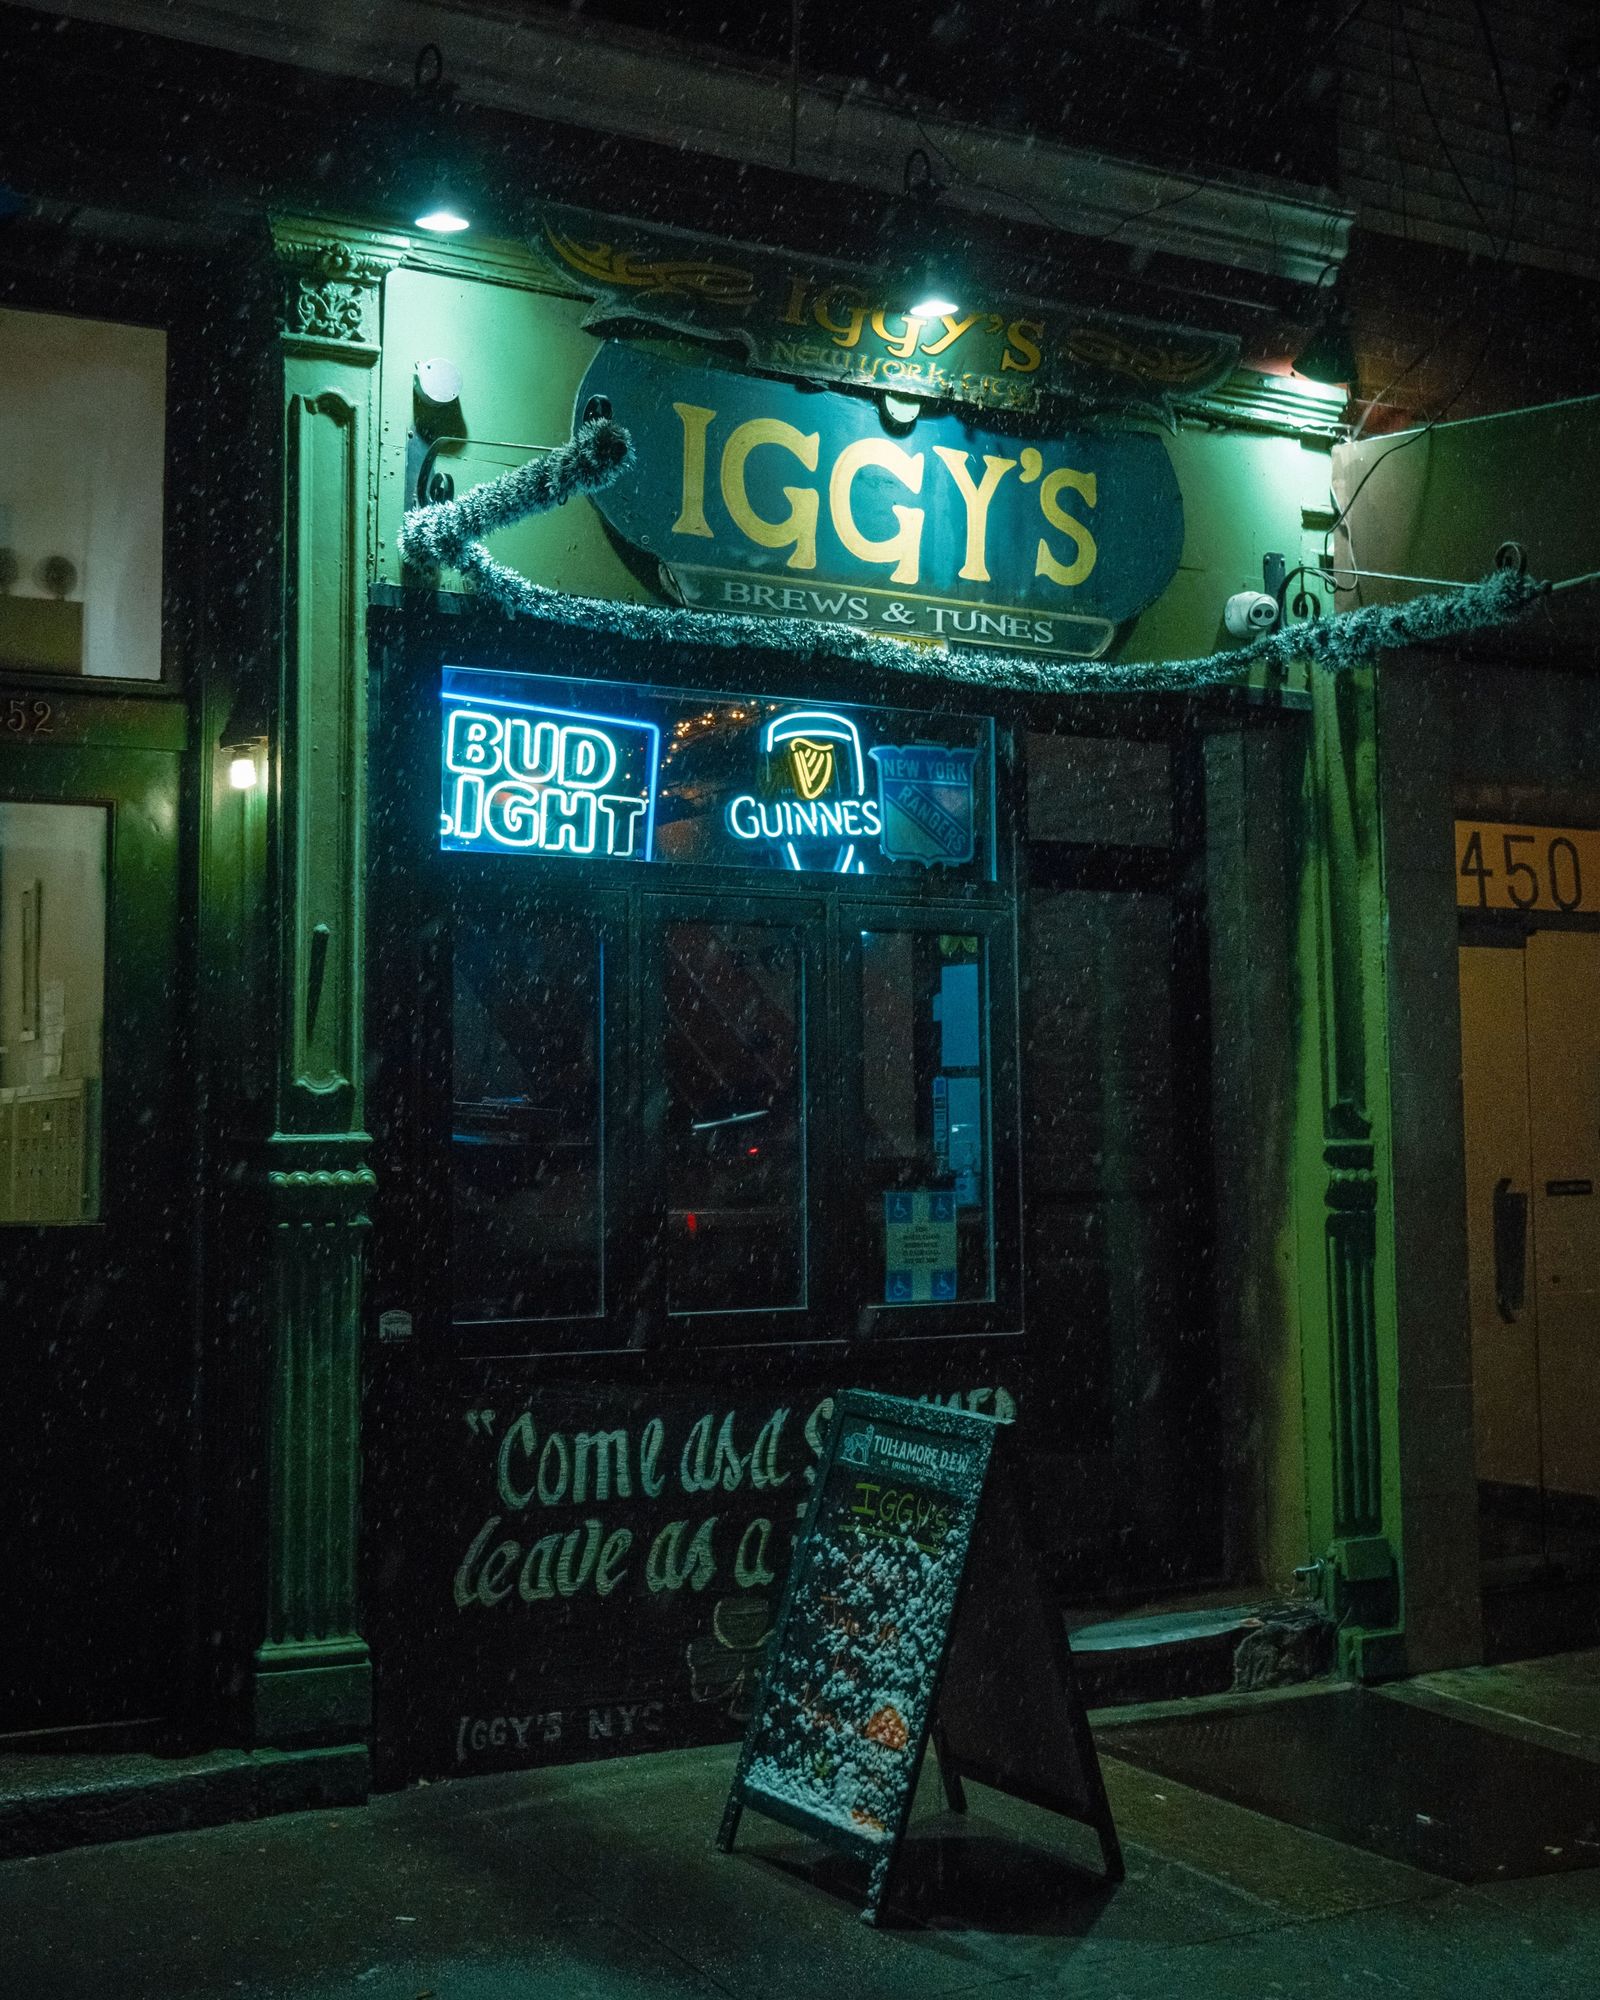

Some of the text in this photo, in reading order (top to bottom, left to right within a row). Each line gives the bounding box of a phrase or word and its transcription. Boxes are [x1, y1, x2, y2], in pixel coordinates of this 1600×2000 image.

[671, 401, 1098, 587] IGGY'S
[724, 581, 1054, 644] BREWS & TUNES
[0, 699, 54, 734] 52
[446, 709, 617, 790] BUD
[884, 759, 968, 782] NEW YORK
[440, 774, 648, 857] IGHT
[898, 785, 968, 852] RANGERS
[1461, 831, 1582, 912] 450
[680, 1410, 752, 1493] as
[750, 1407, 793, 1490] a
[874, 1435, 938, 1467] TULLAMORE
[646, 1516, 719, 1593] as
[734, 1517, 776, 1589] a
[456, 1702, 665, 1762] IGGY'S NYC
